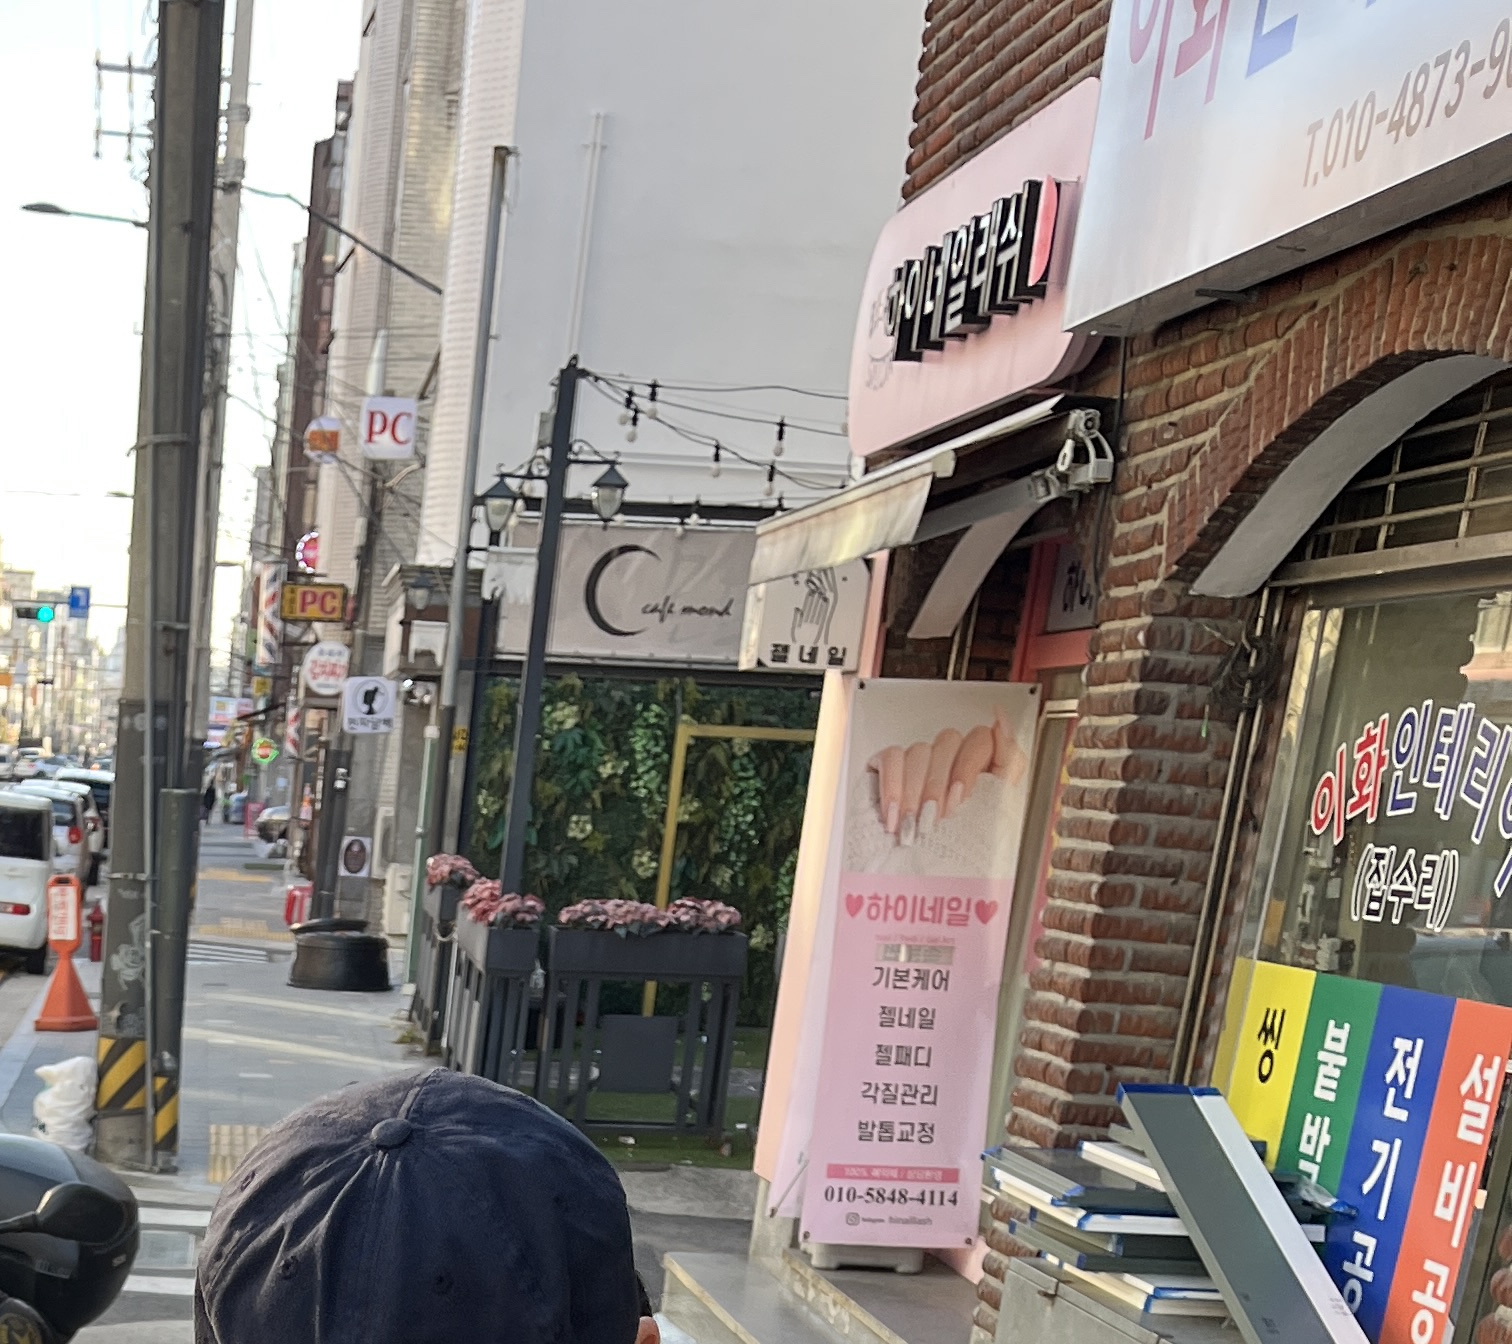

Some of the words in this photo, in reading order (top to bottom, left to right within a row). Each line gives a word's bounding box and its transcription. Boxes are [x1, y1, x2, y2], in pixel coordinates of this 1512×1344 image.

[1303, 17, 1512, 188] T.010-4873-9
[364, 410, 413, 444] PC
[300, 590, 337, 615] PC
[866, 894, 971, 927] 하이네일
[871, 966, 951, 991] 기본케어
[879, 1005, 937, 1030] 젤네일
[875, 1044, 932, 1068] 젤패디
[861, 1081, 938, 1106] 각질관리
[858, 1119, 935, 1144] 발톱교정
[824, 1186, 959, 1207] 010-5848-4114
